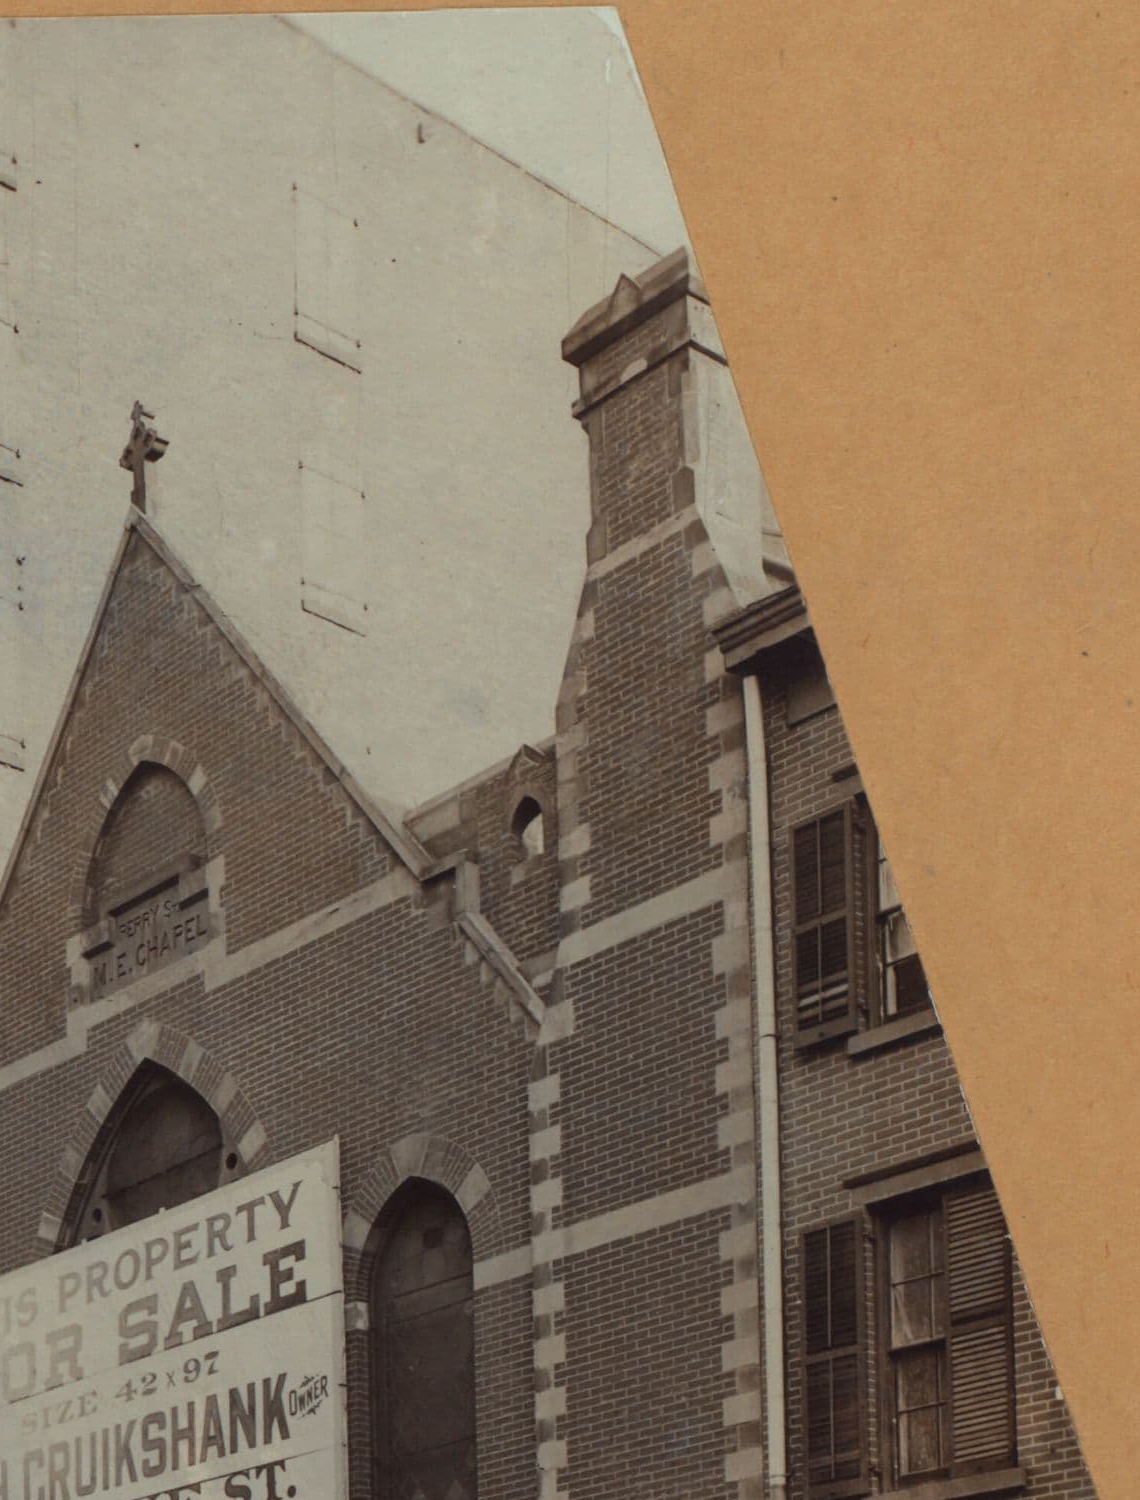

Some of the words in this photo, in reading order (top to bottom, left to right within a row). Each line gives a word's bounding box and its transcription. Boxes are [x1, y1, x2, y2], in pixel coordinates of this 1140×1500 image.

[119, 904, 159, 937] PERRY
[59, 1180, 303, 1313] PROPERTY
[118, 1239, 307, 1366] SALE
[21, 1388, 98, 1436] SIZE
[115, 1371, 157, 1403] 42
[183, 1350, 220, 1385] 97
[289, 1375, 329, 1416] OWNER
